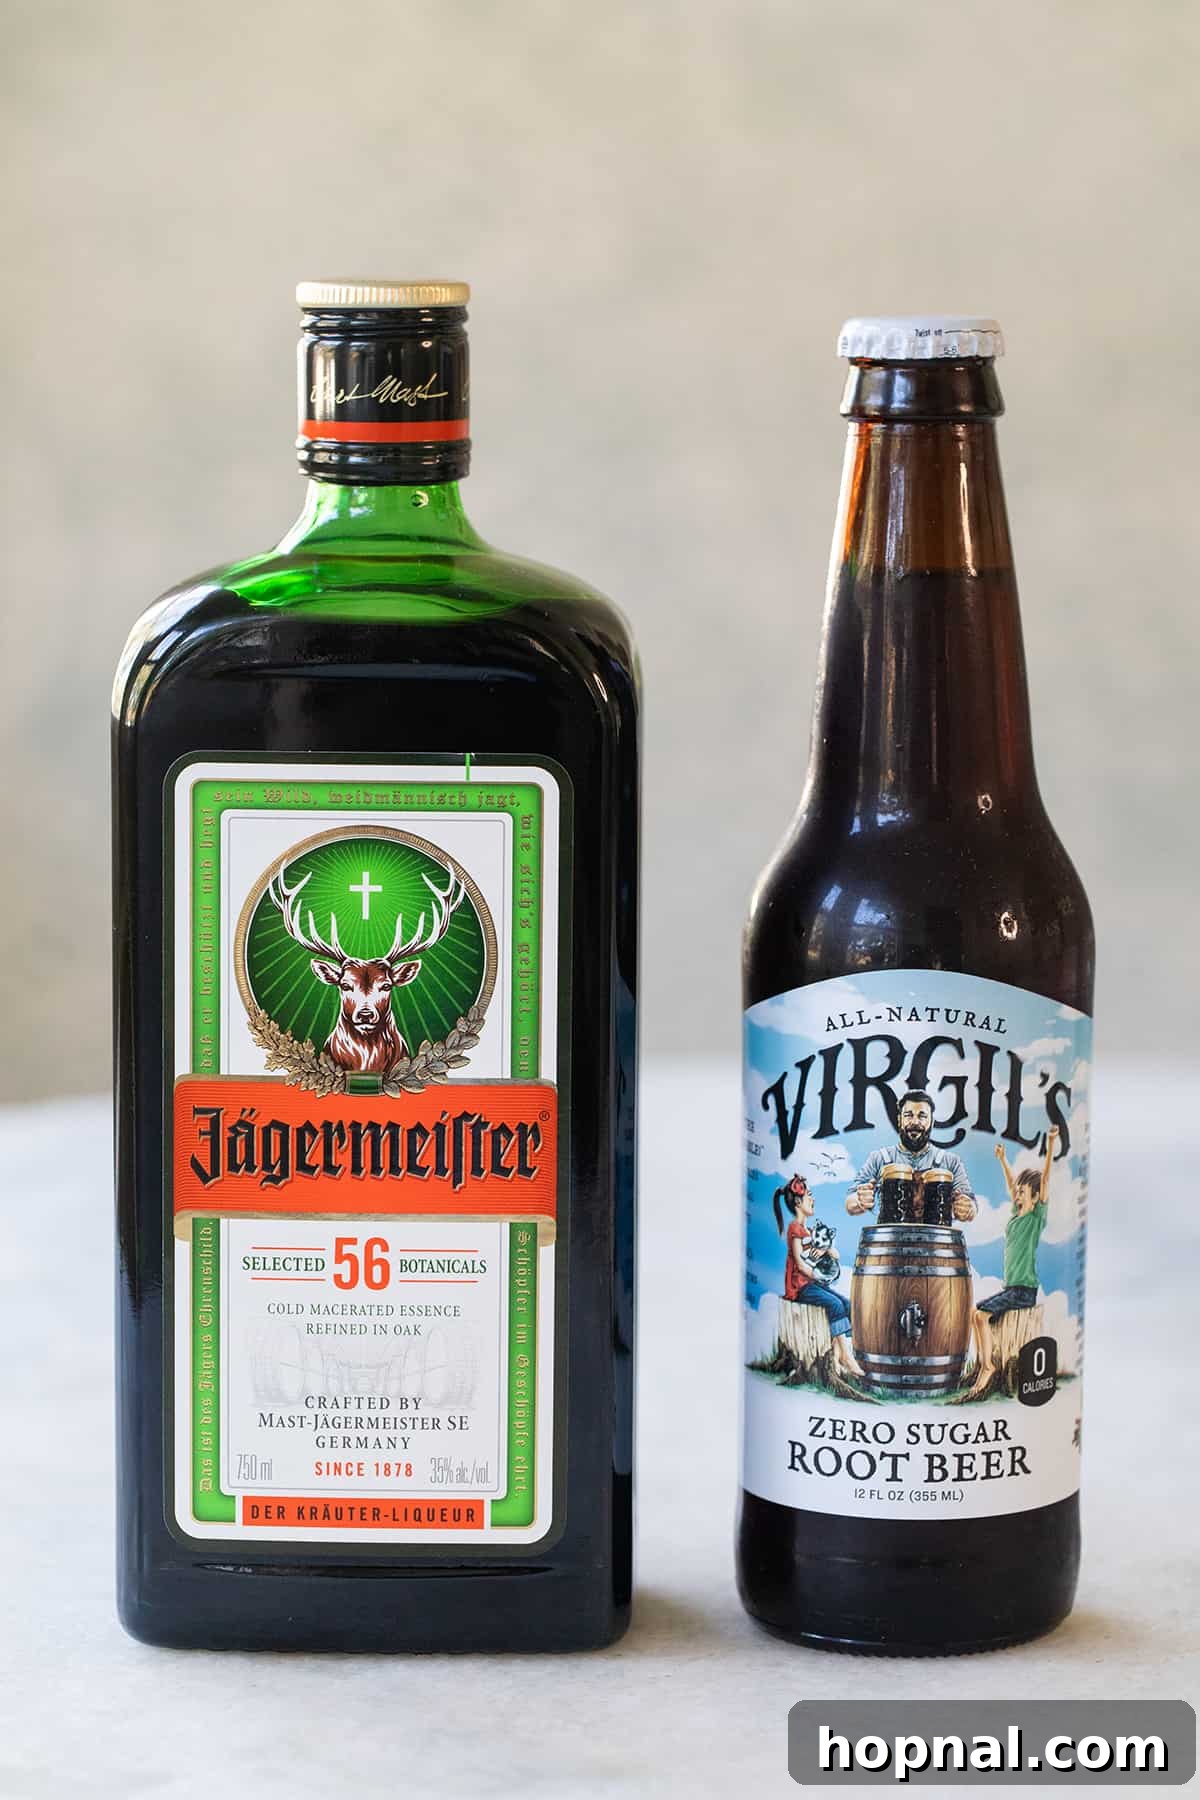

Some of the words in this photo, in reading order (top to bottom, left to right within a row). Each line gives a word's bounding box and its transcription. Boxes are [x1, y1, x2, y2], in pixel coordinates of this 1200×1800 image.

[825, 1006, 1008, 1034] ALL-NATURAL
[762, 1034, 1072, 1162] VIRGIL'S
[242, 1256, 326, 1272] SELECTED
[333, 1236, 391, 1291] 56
[399, 1258, 487, 1274] BOTANICALS
[267, 1302, 305, 1315] COLD
[309, 1303, 394, 1317] MACERATED
[400, 1304, 461, 1317] ESSENCE
[306, 1322, 368, 1335] REFINED
[373, 1323, 388, 1335] IN
[393, 1323, 423, 1336] OAK
[1033, 1347, 1046, 1376] 0
[1023, 1377, 1054, 1394] CALORIES
[304, 1395, 391, 1410] CRAFTED
[399, 1396, 422, 1410] BY
[258, 1412, 442, 1432] MAST-JÄGERMEISTER
[447, 1415, 469, 1431] SE
[808, 1416, 896, 1444] ZERO
[906, 1418, 1012, 1445] SUGAR
[315, 1435, 411, 1450] GERMANY
[236, 1454, 257, 1481] 750
[260, 1458, 272, 1481] ml
[315, 1461, 366, 1477] SINCE
[374, 1462, 413, 1477] 1878
[429, 1456, 453, 1485] 35%
[787, 1440, 910, 1482] ROOT
[923, 1446, 1032, 1483] BEER
[854, 1488, 866, 1499] 12
[869, 1489, 884, 1500] FL
[888, 1490, 905, 1501] OZ
[909, 1489, 937, 1503] (355
[941, 1489, 964, 1503] ML)
[251, 1504, 286, 1519] DER
[296, 1503, 475, 1522] KRÄUTER-LIQUEUR
